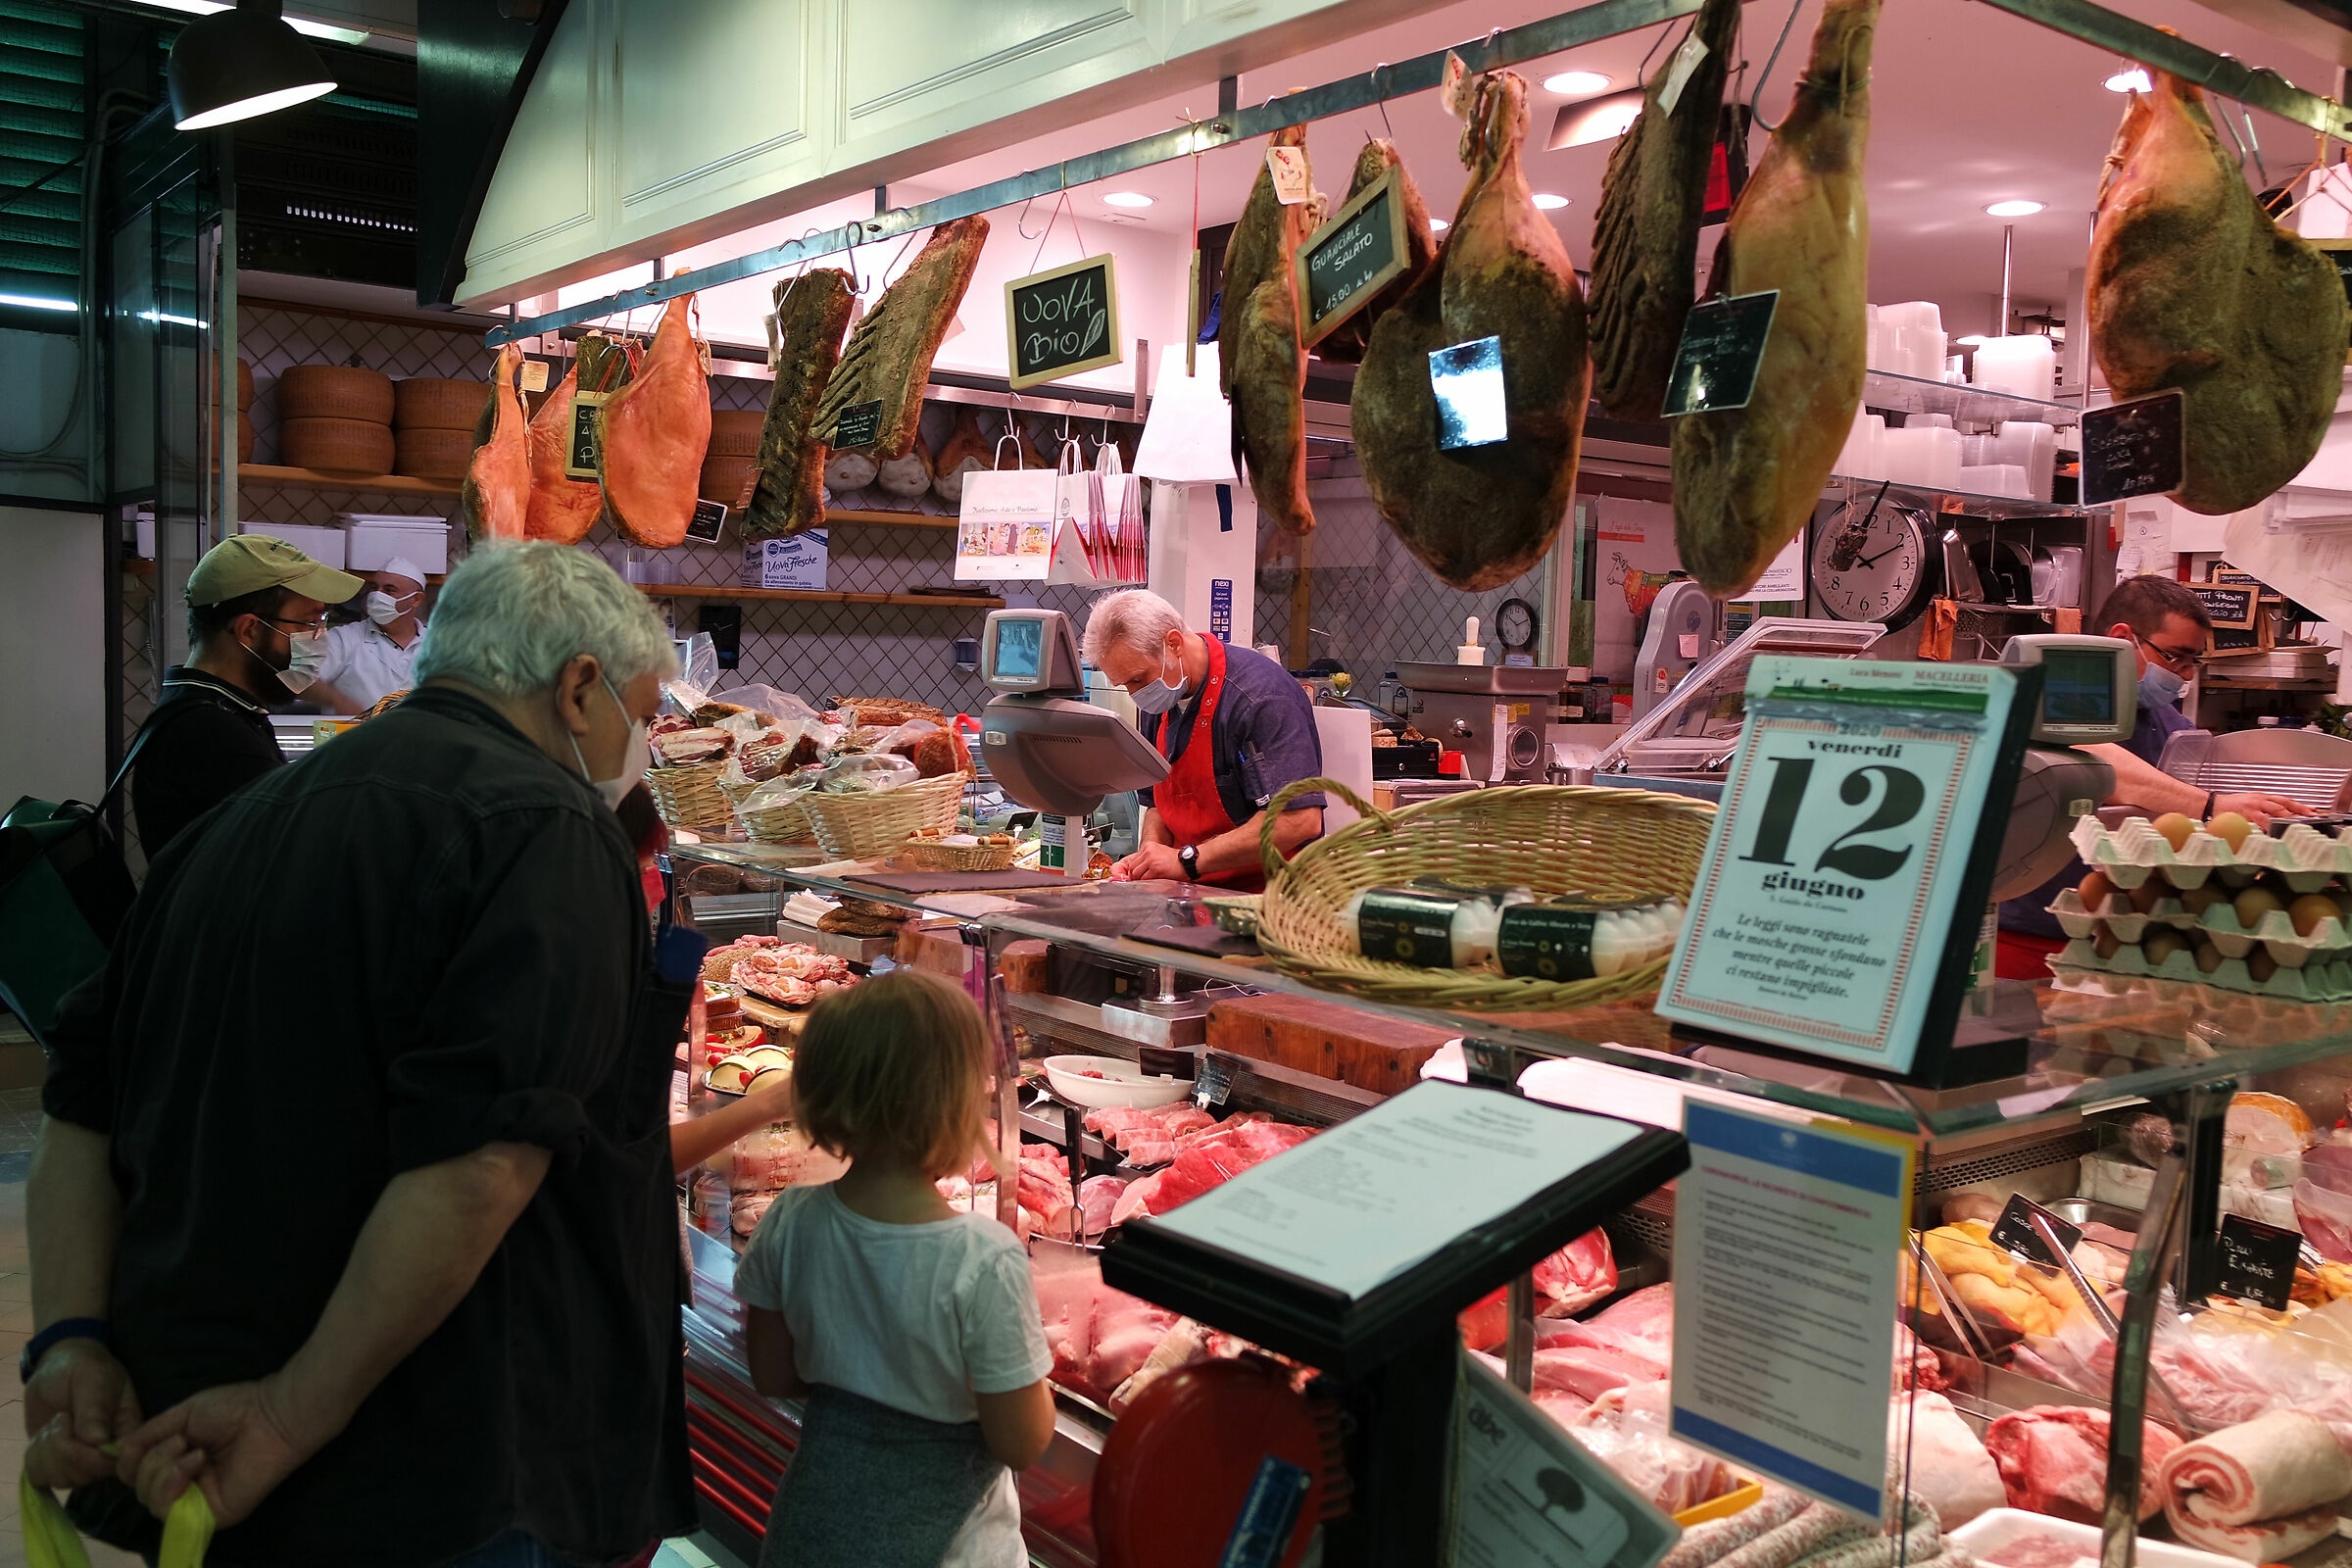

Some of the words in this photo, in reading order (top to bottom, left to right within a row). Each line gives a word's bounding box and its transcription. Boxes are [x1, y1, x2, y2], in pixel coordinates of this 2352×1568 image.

[1334, 232, 1373, 271] SALATO
[1885, 519, 1891, 534] 1
[1901, 556, 1910, 570] 3
[1831, 575, 1840, 590] 8
[1892, 576, 1902, 590] 4
[1845, 591, 1853, 606] 7
[1859, 596, 1870, 612] 6
[1880, 591, 1889, 607] 5
[1914, 668, 1989, 684] MACELLERIA
[1838, 722, 1883, 738] 2020
[1738, 756, 1927, 881] 12
[1760, 869, 1866, 902] giugno
[1736, 913, 1752, 925] Le
[1752, 915, 1783, 932] leggi
[1784, 923, 1811, 935] sono
[1811, 928, 1870, 947] ragnatele
[1712, 927, 1733, 940] che
[1734, 930, 1745, 941] le
[1747, 934, 1789, 950] mosche
[1788, 942, 1829, 957] grosse
[1829, 950, 1887, 967] sfondano
[1733, 950, 1774, 965] mentre
[1775, 956, 1811, 972] quelle
[1811, 964, 1855, 980] piccole
[1726, 964, 1738, 975] ci
[1739, 968, 1782, 984] restano
[1783, 975, 1849, 998] impigliate.
[1997, 1230, 2006, 1241] €
